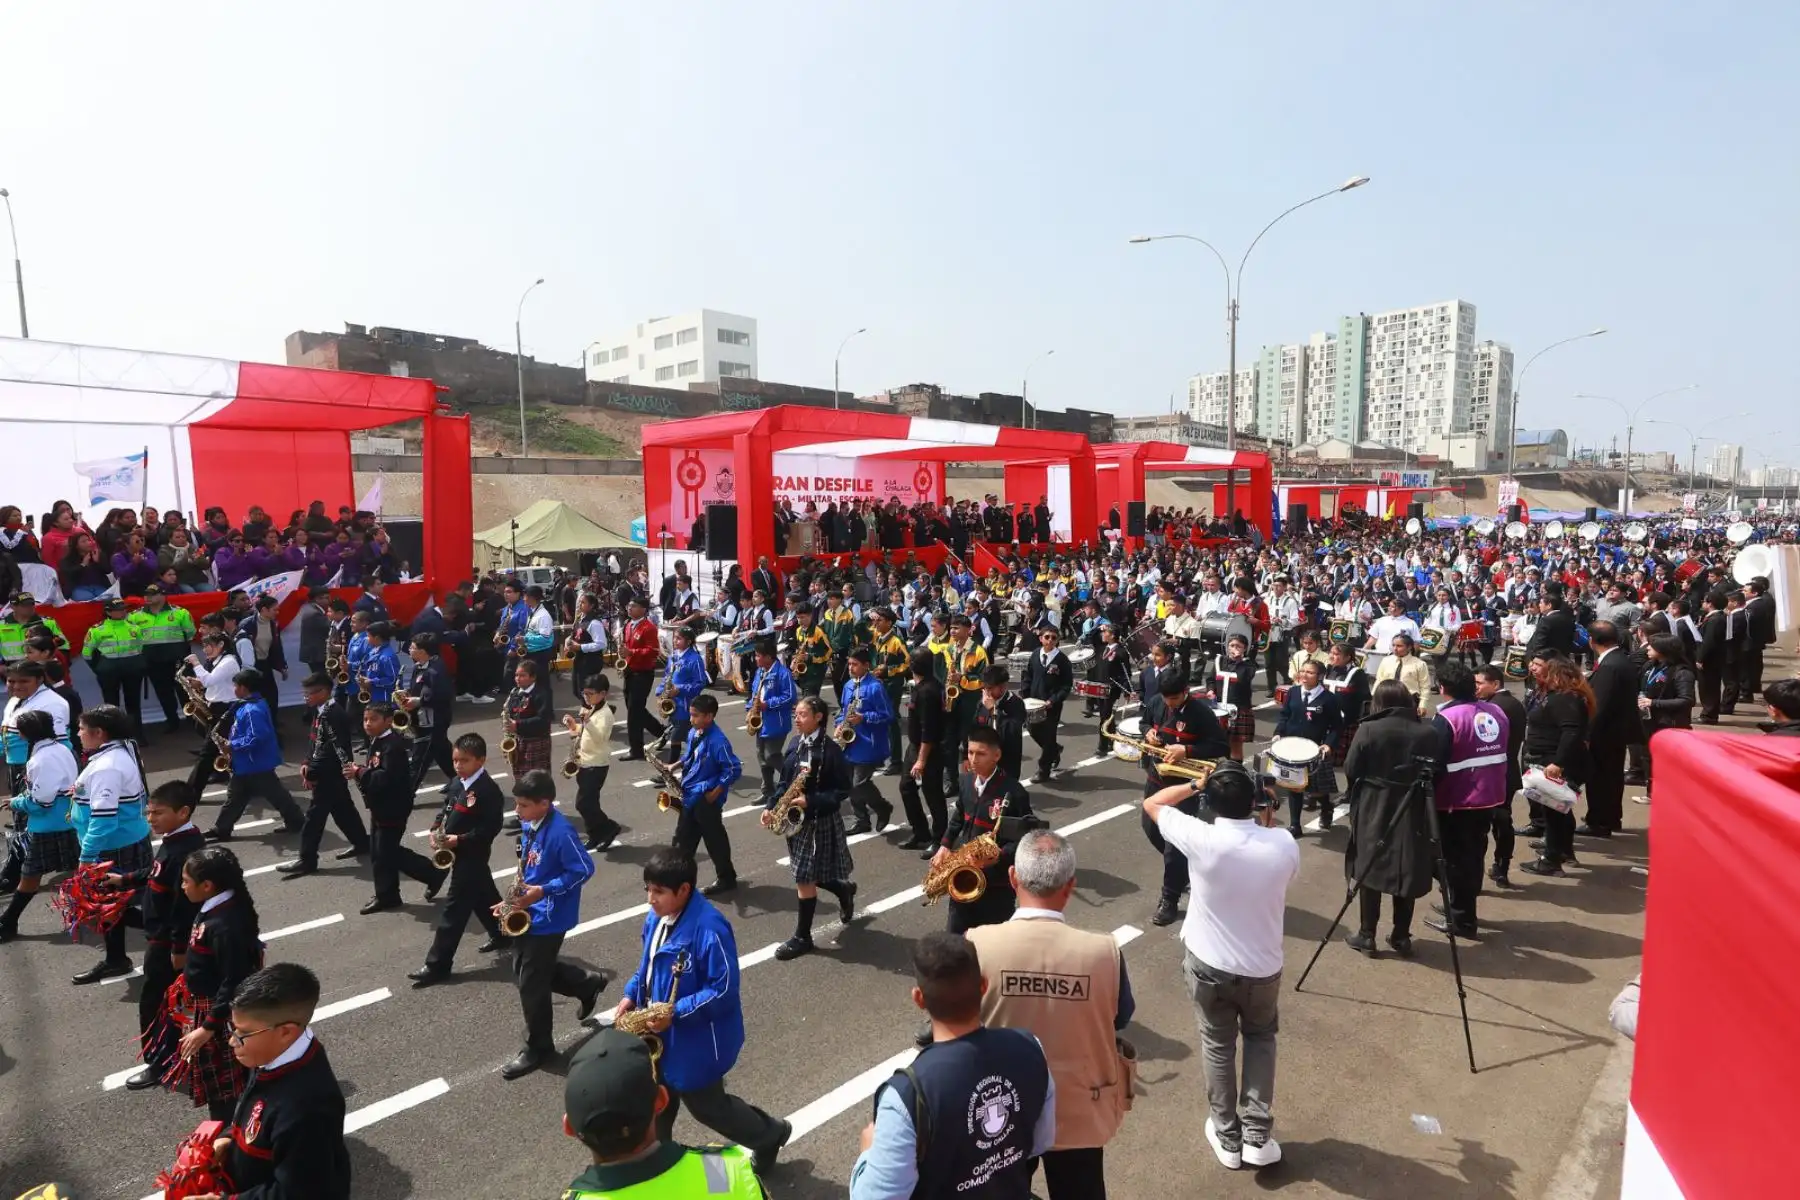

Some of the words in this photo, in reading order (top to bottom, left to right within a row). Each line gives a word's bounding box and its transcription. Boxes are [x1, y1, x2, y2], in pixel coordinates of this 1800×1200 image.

[814, 477, 873, 492] DESFILE
[797, 495, 832, 503] MILITAR
[1006, 976, 1083, 996] PRENSA
[1004, 1146, 1016, 1157] DE
